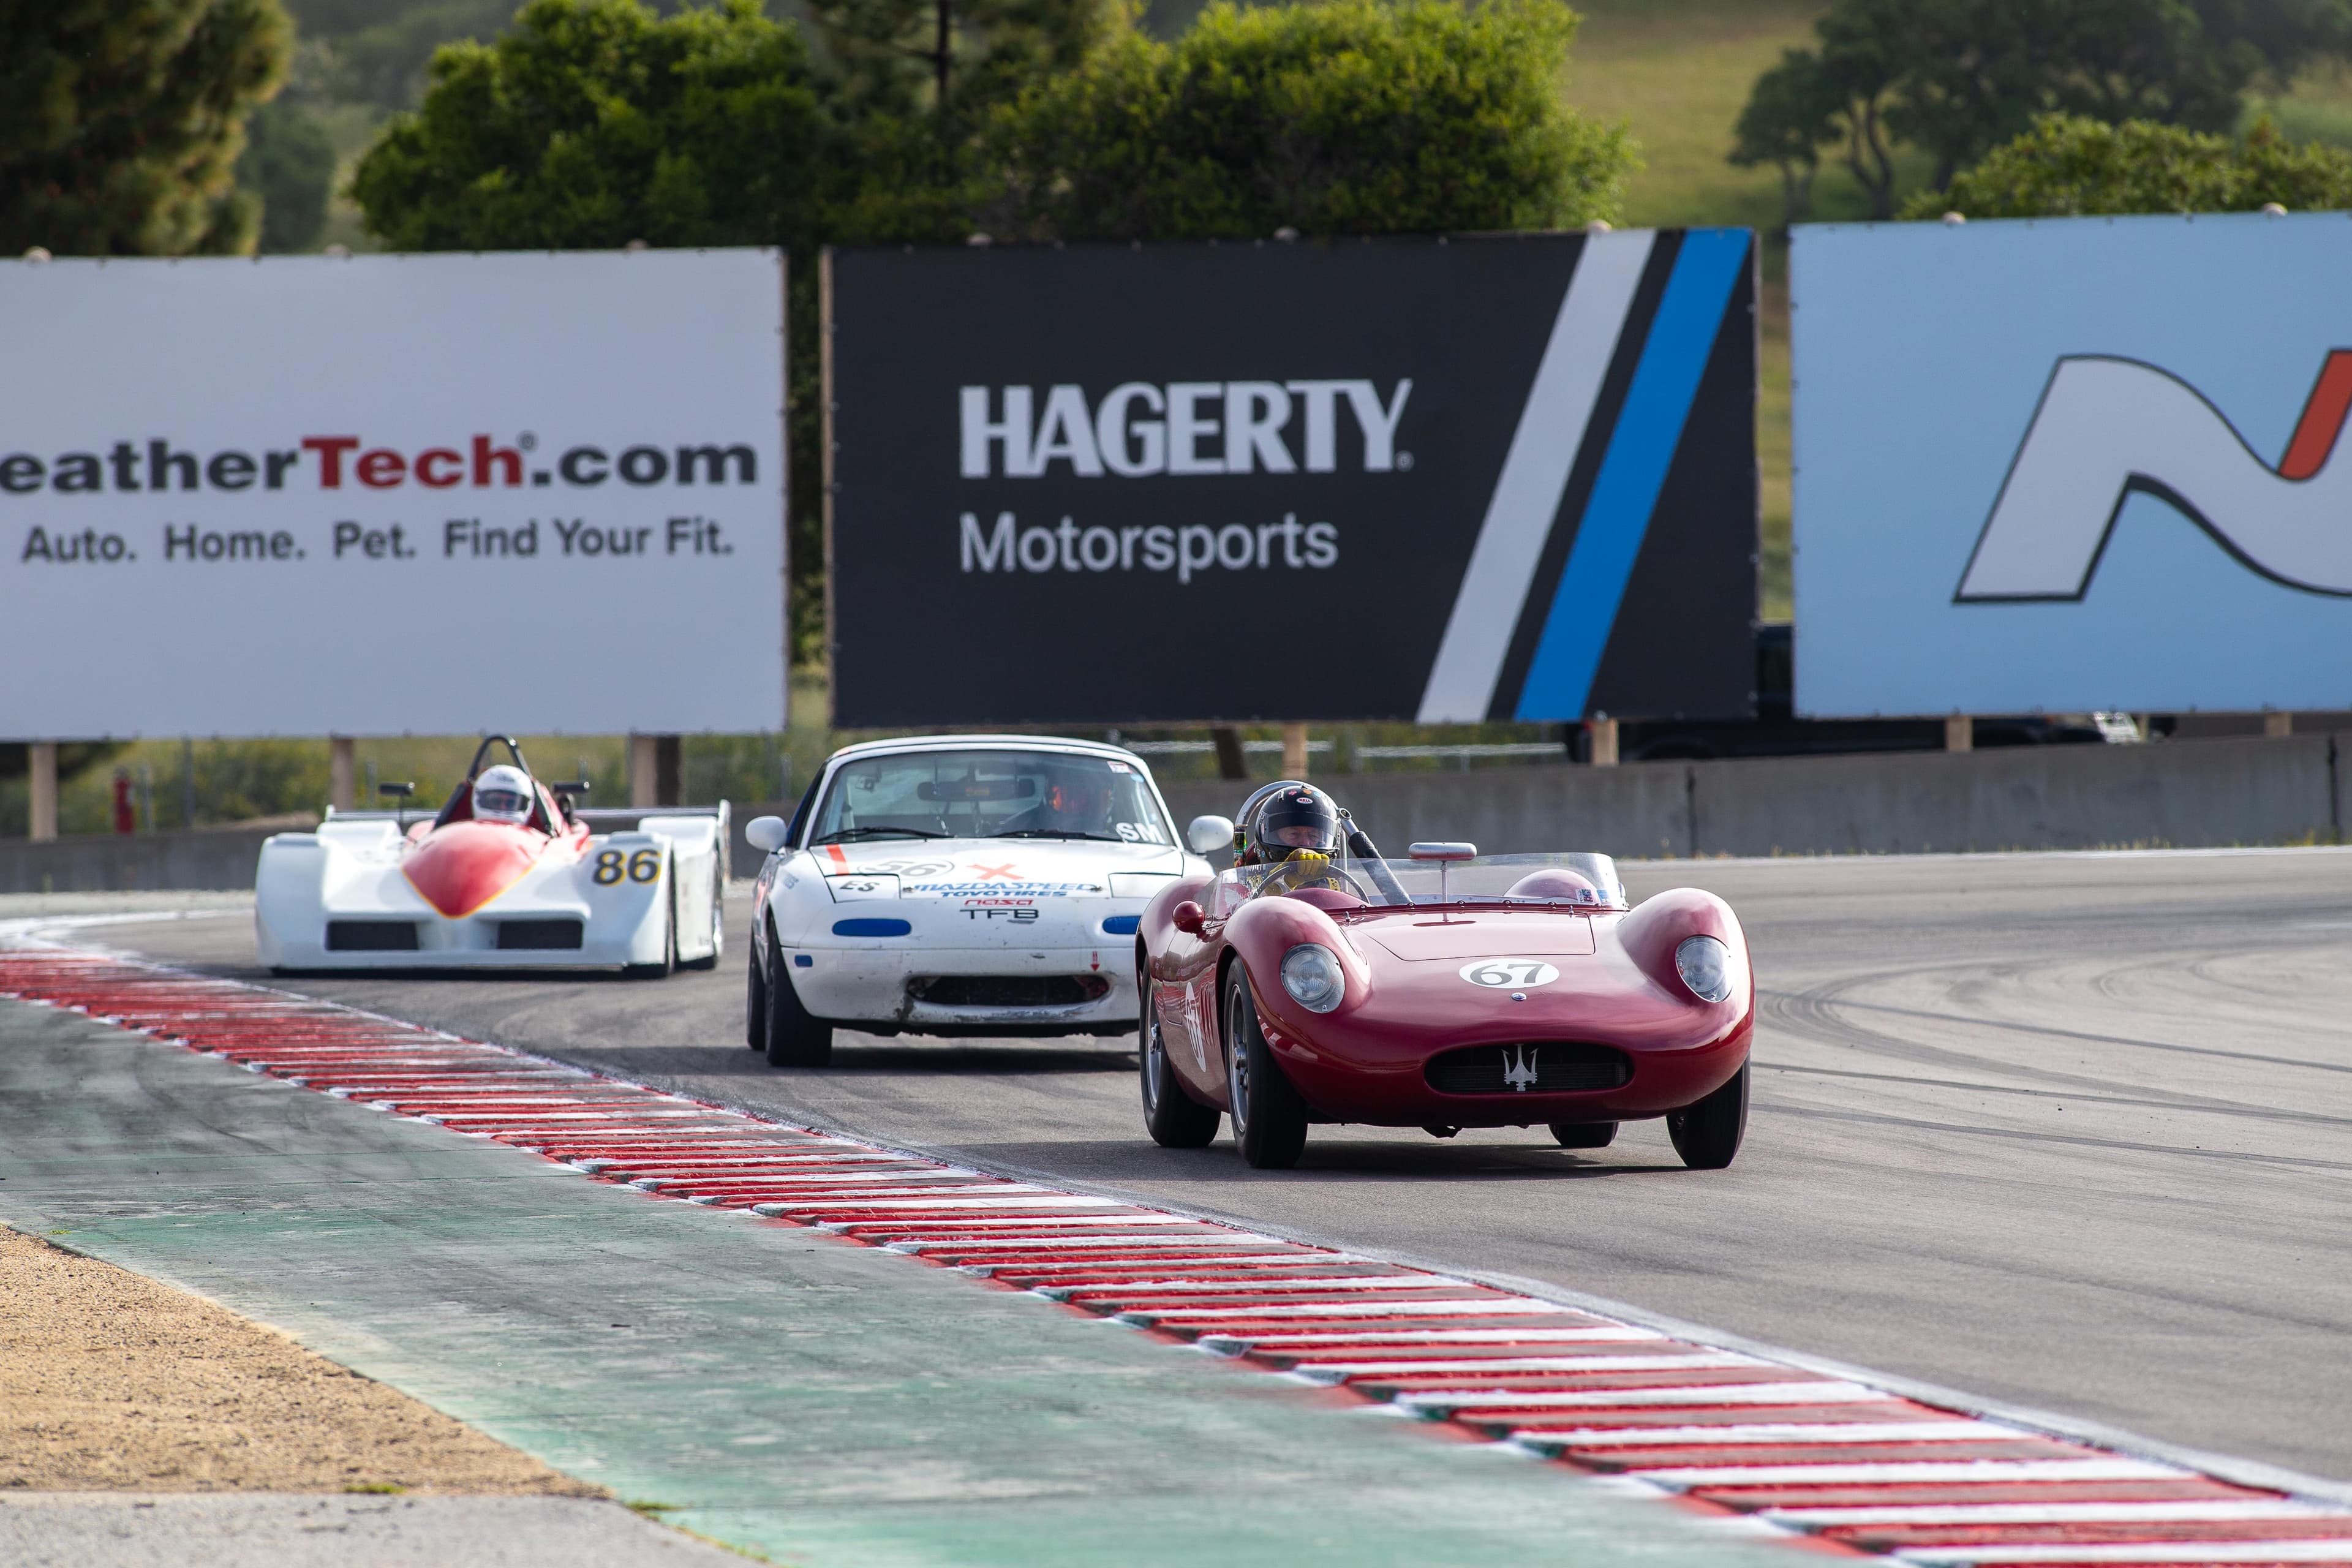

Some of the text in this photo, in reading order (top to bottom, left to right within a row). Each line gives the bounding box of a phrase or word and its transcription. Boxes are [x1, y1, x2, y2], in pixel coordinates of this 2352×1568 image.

[960, 378, 1414, 478] HAGERTY
[22, 516, 733, 562] Auto. Home. Pet. Find Your Fit.
[960, 511, 1339, 584] Motorsports
[1116, 822, 1166, 845] SM
[592, 850, 663, 886] 86
[865, 861, 946, 876] 56
[914, 882, 1096, 892] MAZDASPEED
[960, 909, 1039, 919] TFB
[1470, 963, 1545, 986] 67
